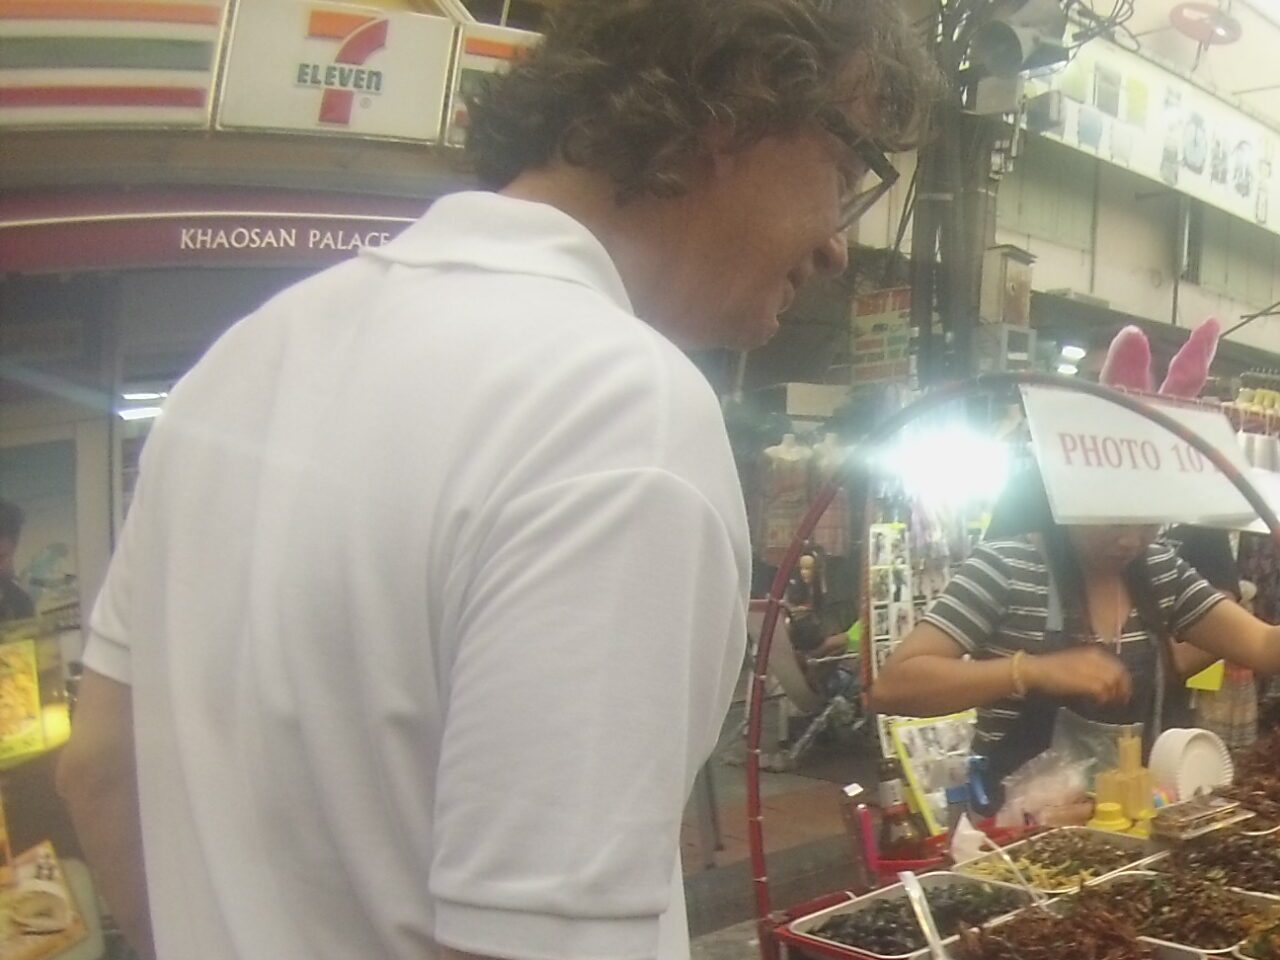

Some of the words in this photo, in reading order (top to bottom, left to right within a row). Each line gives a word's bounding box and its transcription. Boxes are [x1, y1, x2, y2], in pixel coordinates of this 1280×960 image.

[307, 9, 389, 125] 7
[180, 228, 296, 249] KHAOSAN
[1057, 432, 1161, 471] PHOTO
